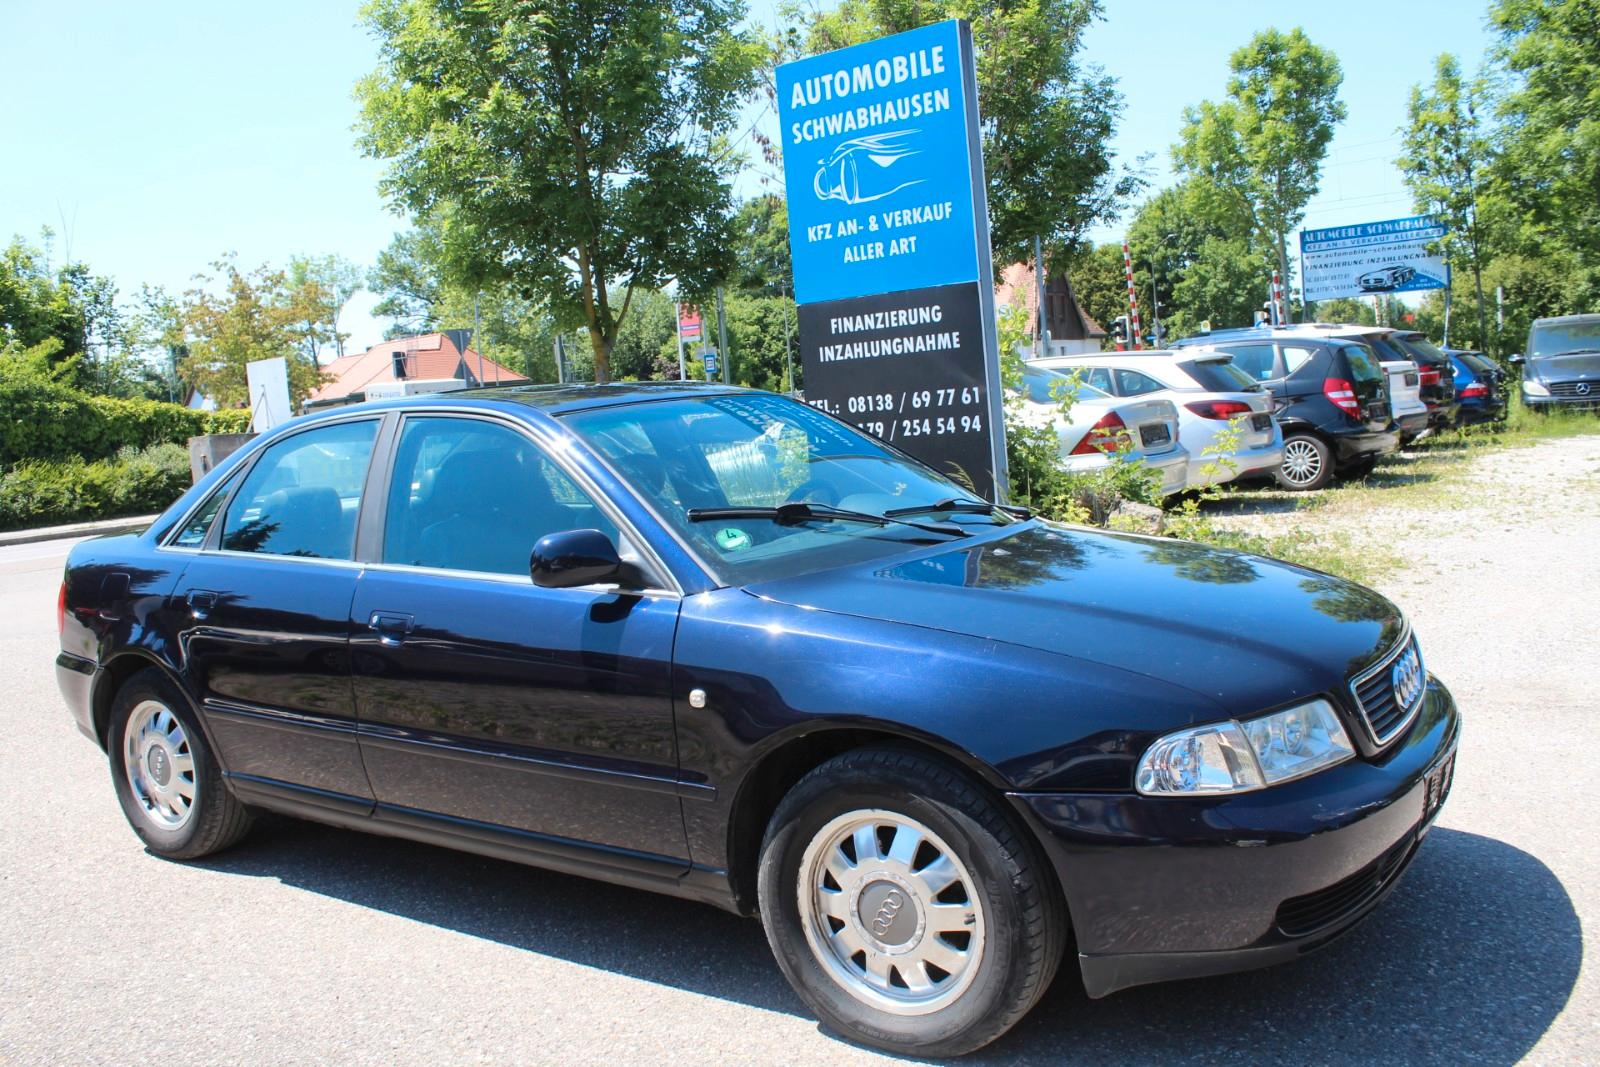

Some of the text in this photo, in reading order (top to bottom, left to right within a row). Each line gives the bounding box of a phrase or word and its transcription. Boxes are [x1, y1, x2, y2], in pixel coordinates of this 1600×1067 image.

[791, 45, 946, 109] AUTOMOBILE
[792, 88, 950, 144] SCHWABHAUSEN
[808, 202, 953, 243] KFZ AN- & VERKAUF
[844, 236, 917, 264] ALLER ART
[830, 304, 943, 335] FINANZIERUNG
[819, 331, 961, 363] INZAHLUNGNAHME
[848, 393, 894, 414] 08138
[899, 392, 907, 414] /
[912, 390, 931, 409] 69
[936, 388, 956, 407] 77
[961, 387, 980, 405] 61
[889, 420, 897, 442] /
[902, 417, 931, 437] 254
[937, 417, 956, 435] 54
[961, 415, 982, 433] 94
